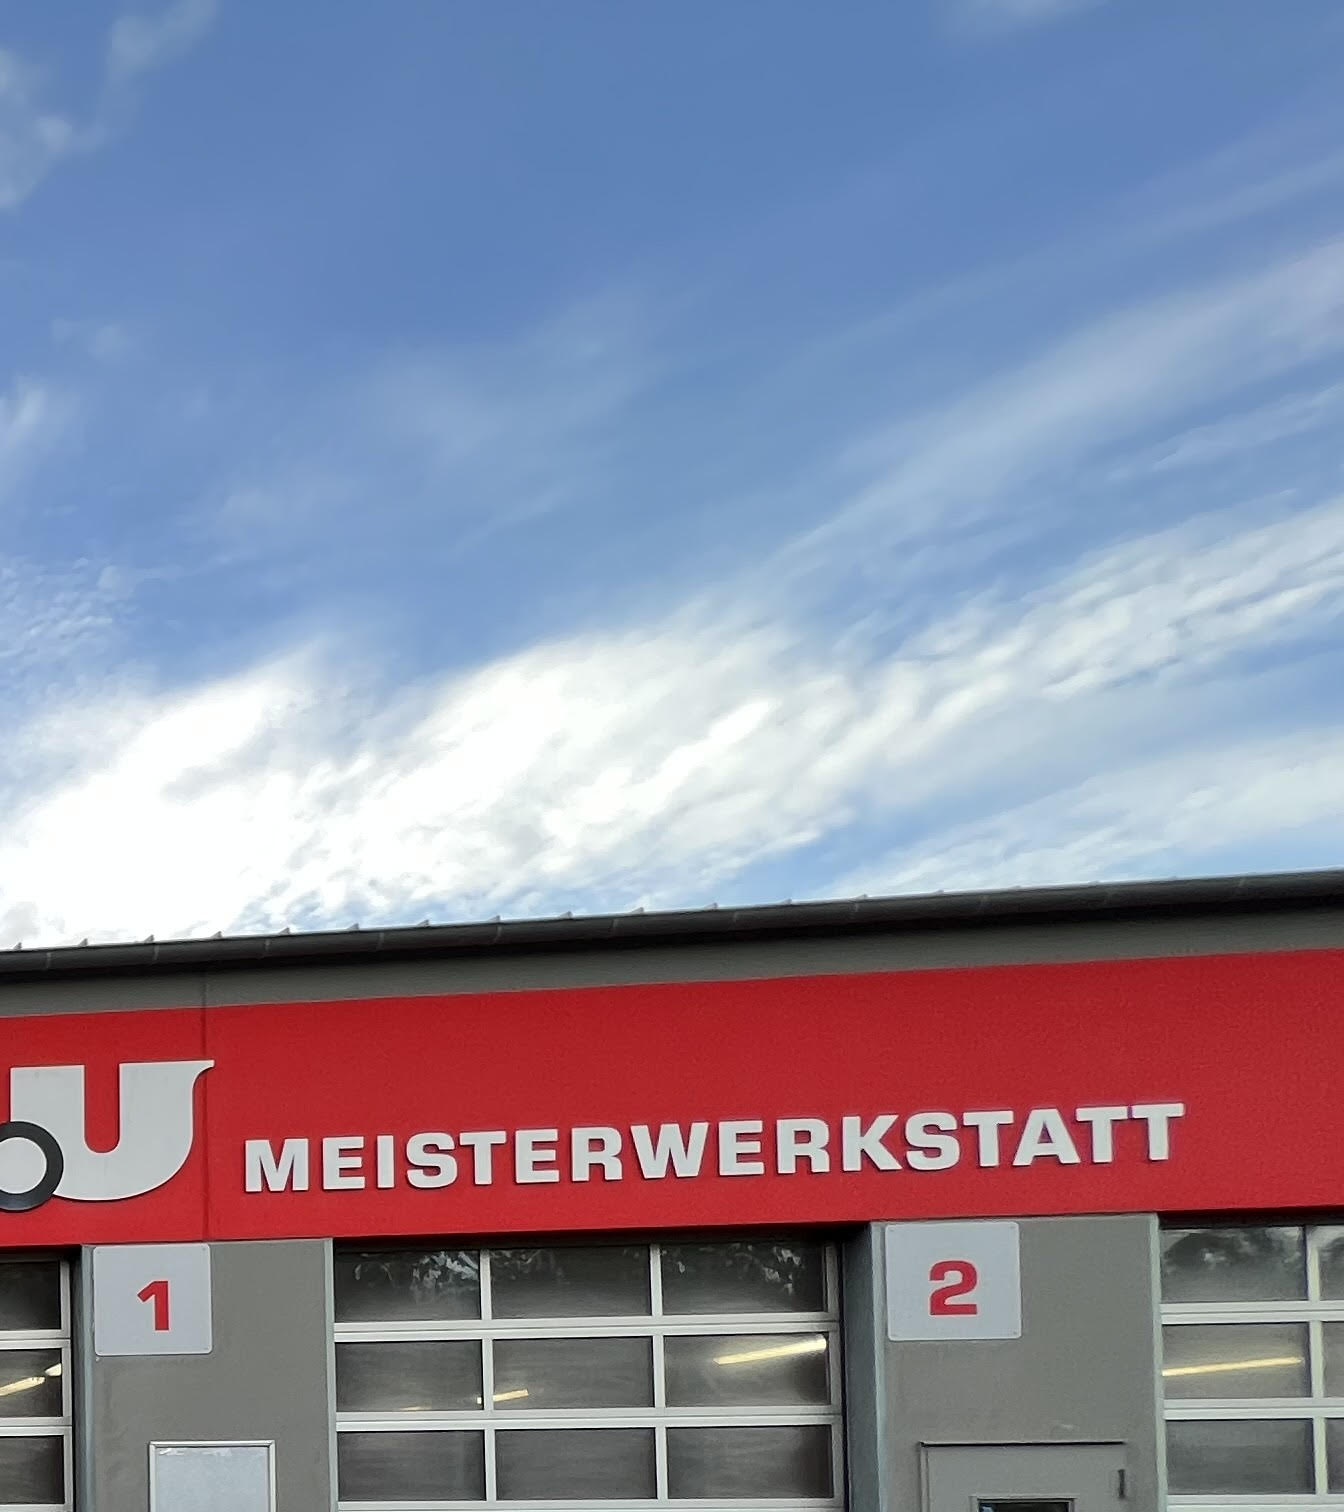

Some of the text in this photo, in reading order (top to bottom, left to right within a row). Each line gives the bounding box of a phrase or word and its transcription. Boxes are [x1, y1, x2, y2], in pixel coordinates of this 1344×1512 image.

[242, 1101, 1185, 1193] MEISTERWERKSTATT
[137, 1280, 170, 1331] 1
[928, 1260, 978, 1316] 2
